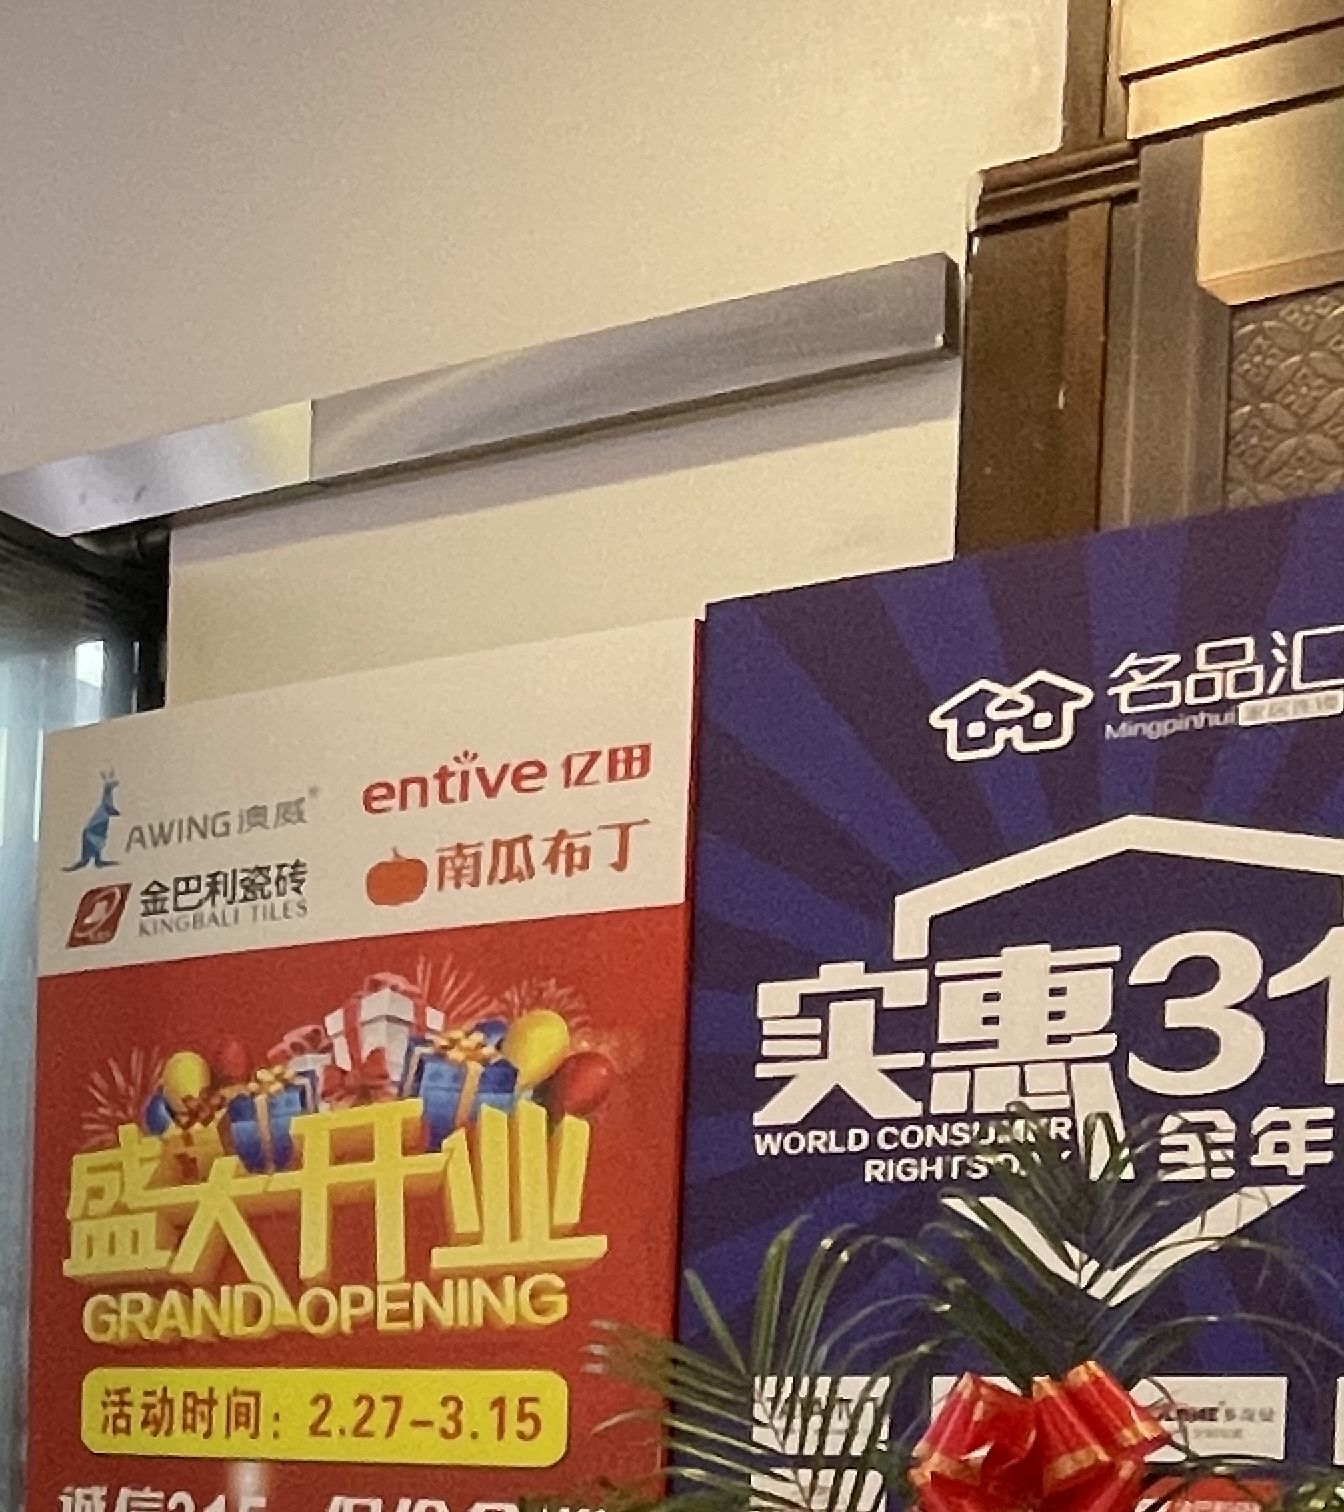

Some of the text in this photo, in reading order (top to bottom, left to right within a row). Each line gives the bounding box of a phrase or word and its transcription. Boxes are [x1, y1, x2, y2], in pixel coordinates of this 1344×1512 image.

[1104, 704, 1237, 741] Mingpinhui
[361, 749, 548, 815] entive
[561, 743, 653, 789] 亿田
[125, 809, 232, 853] AWING
[436, 819, 652, 893] 南瓜布丁
[138, 860, 309, 917] 金巴利瓷砖
[138, 898, 309, 938] KINGBALI TILES
[753, 1115, 1073, 1157] WORLD CONSUR
[1160, 1105, 1335, 1182] 全年
[863, 1151, 990, 1185] RIGHTS
[63, 1099, 609, 1325] 盛大开业
[82, 1272, 570, 1344] GRAND OPENING
